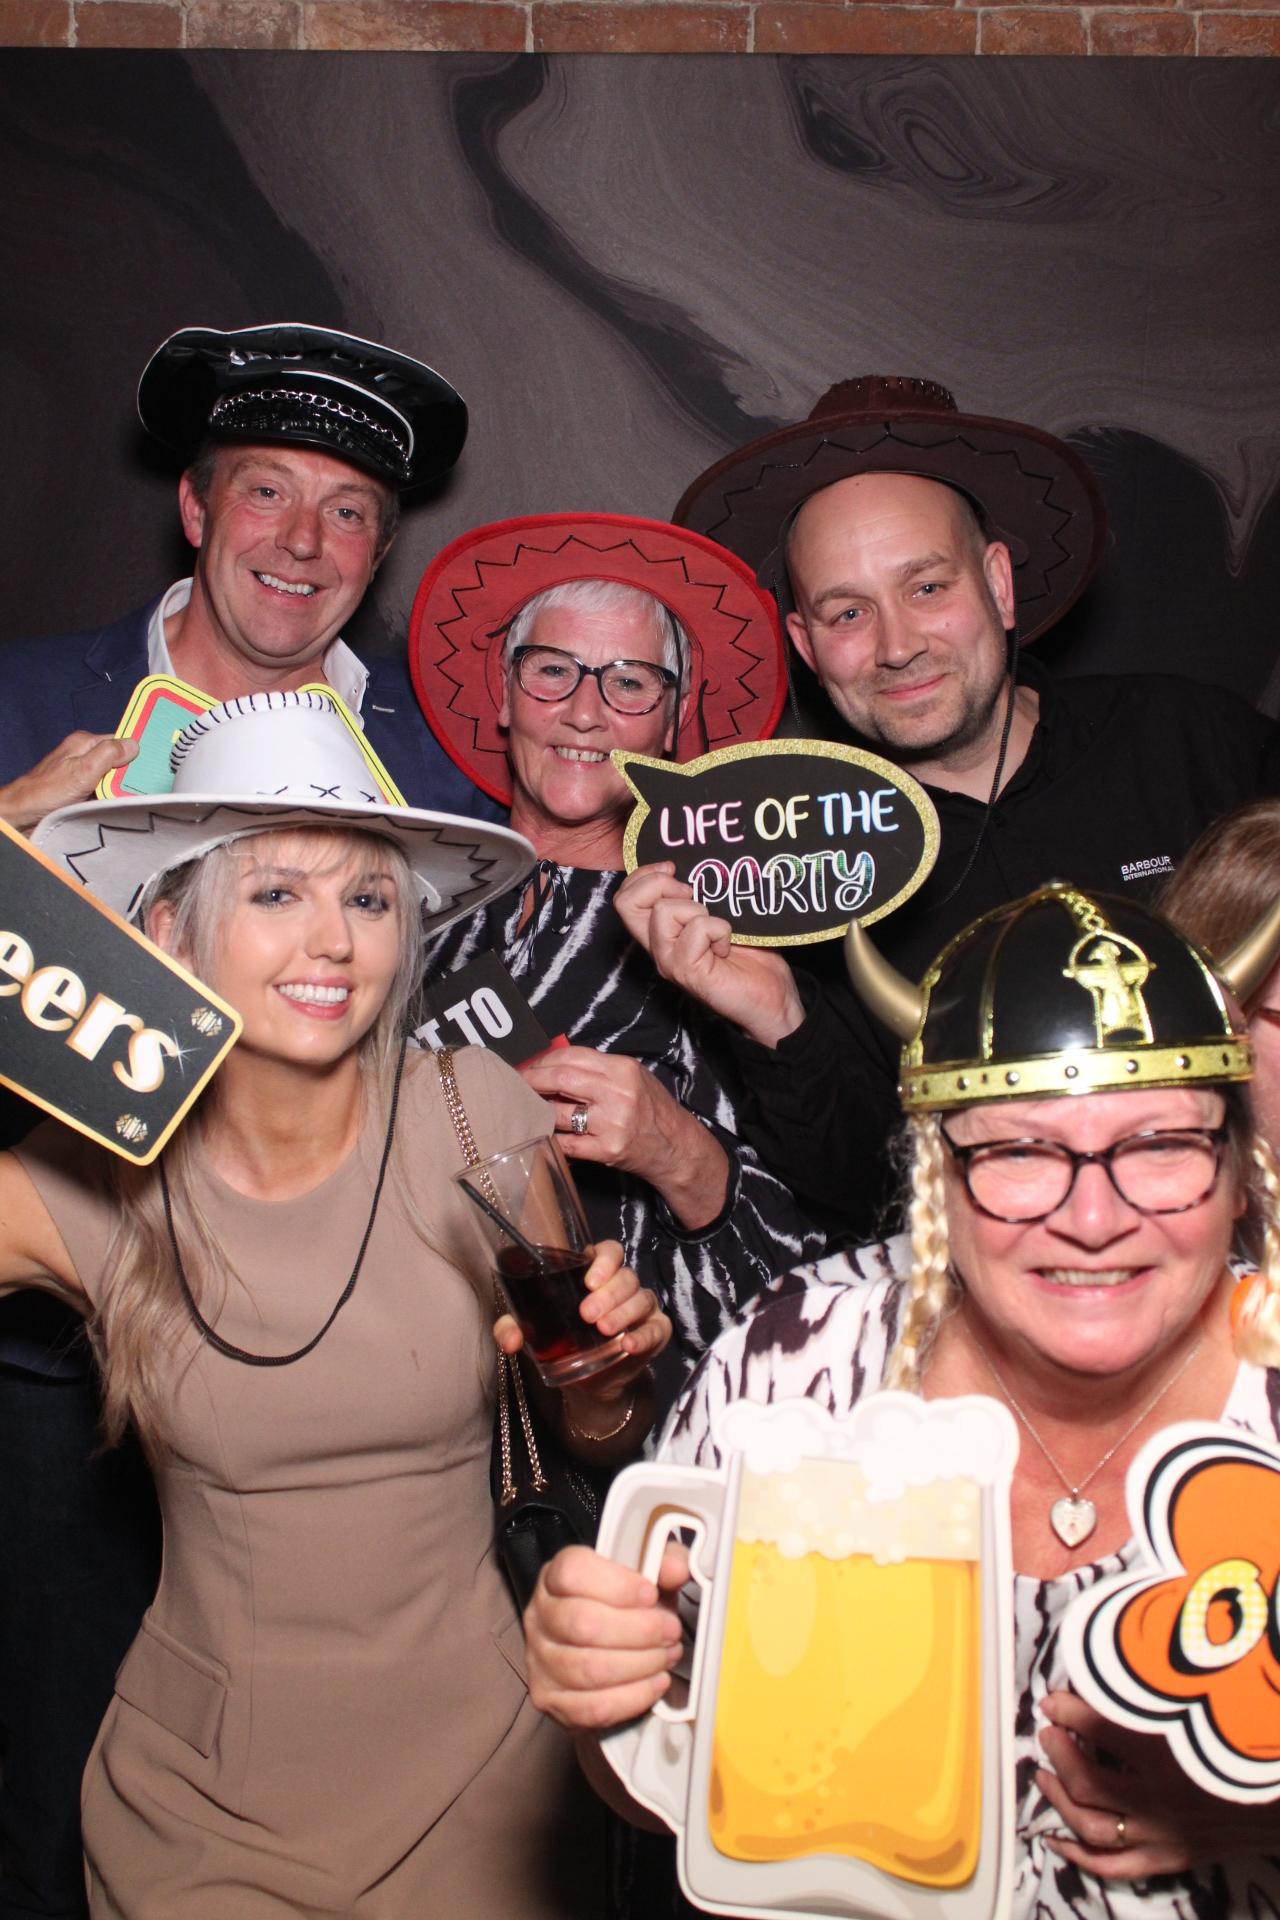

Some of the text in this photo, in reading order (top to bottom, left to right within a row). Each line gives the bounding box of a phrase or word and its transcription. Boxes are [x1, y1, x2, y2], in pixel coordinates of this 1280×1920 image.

[659, 788, 899, 847] LIFE OF THE
[688, 850, 876, 917] PARTY
[1121, 855, 1172, 875] BARBOUR
[1123, 865, 1177, 881] INTERNATIONAL
[443, 987, 513, 1049] TO
